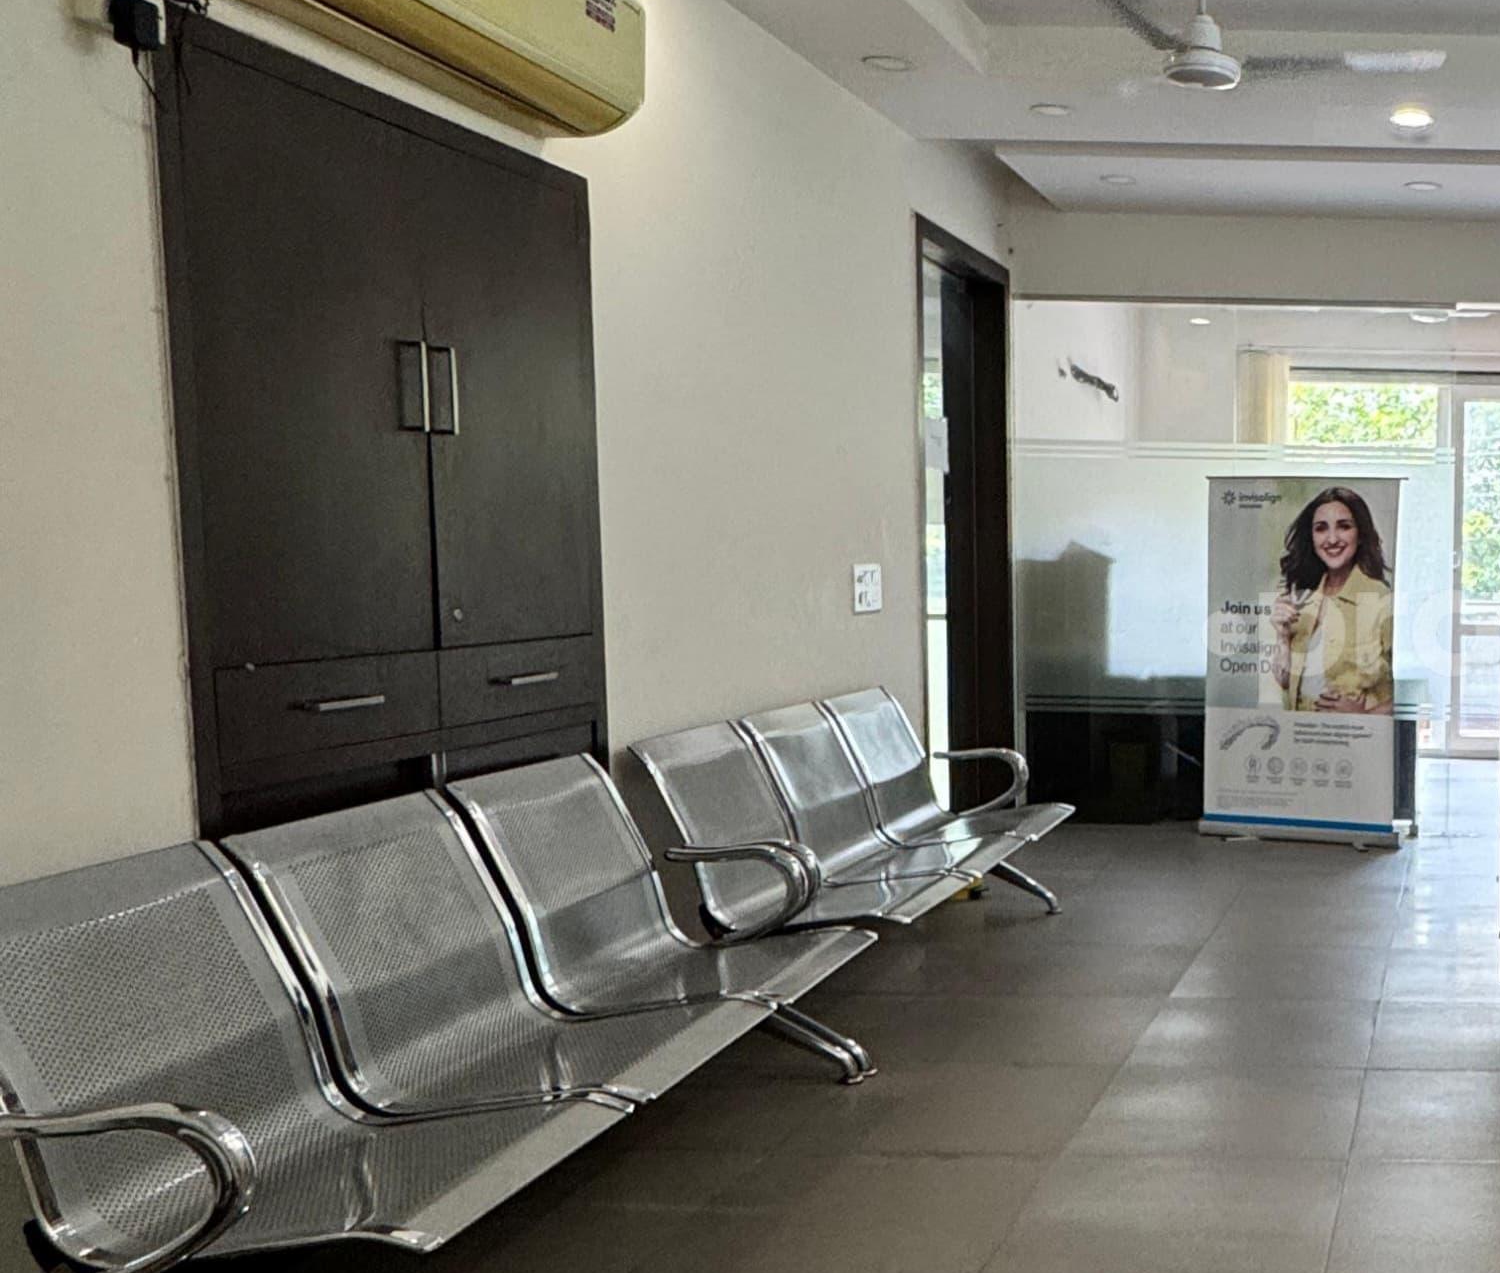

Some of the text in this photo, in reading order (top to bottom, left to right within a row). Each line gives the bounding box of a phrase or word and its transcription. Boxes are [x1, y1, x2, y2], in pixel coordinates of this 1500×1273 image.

[1239, 491, 1282, 505] invisalign
[1220, 600, 1272, 615] Join us
[1220, 622, 1257, 635] at our
[1220, 639, 1281, 657] Invisalign
[1220, 657, 1258, 675] Open
